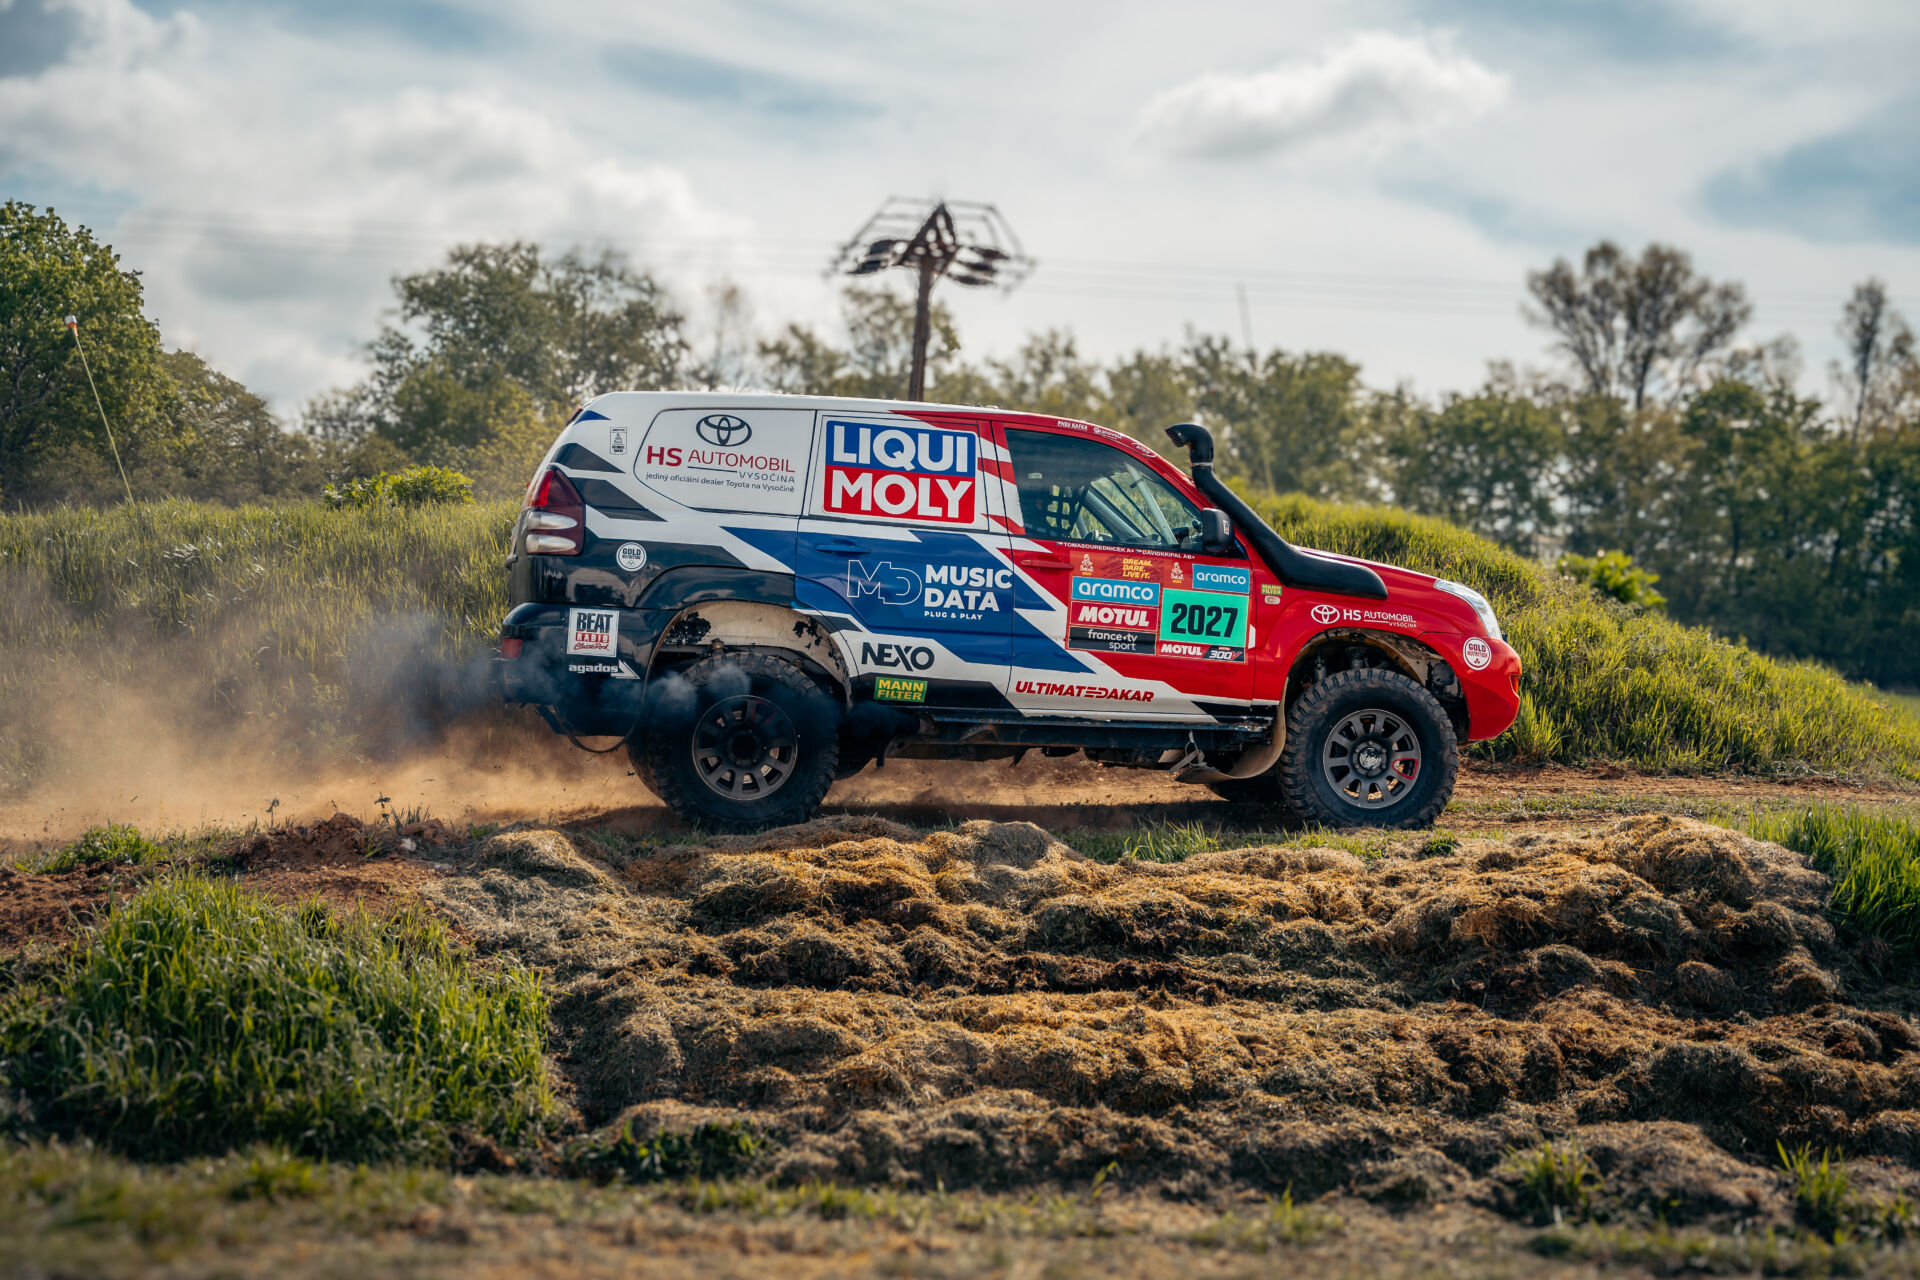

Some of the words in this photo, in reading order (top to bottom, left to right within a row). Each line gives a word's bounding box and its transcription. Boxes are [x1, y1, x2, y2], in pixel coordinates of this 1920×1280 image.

[833, 425, 968, 471] LIQUI
[646, 445, 682, 467] HS
[688, 449, 796, 473] AUTOMOBIL
[645, 471, 668, 482] jediný
[670, 473, 700, 484] oficiální
[700, 476, 724, 486] dealer
[726, 479, 750, 489] Toyota
[761, 483, 795, 493] Vysočině
[739, 470, 795, 484] VYSOČINA
[831, 469, 973, 519] MOLY
[622, 548, 642, 556] GOLD
[1122, 558, 1153, 567] DREAM.
[1122, 564, 1146, 572] DARE.
[925, 564, 1014, 589] MUSIC
[1196, 571, 1246, 585] aramco
[1078, 582, 1154, 600] aramco
[924, 587, 1000, 612] DATA
[576, 612, 613, 633] BEAT
[924, 611, 948, 619] PLUG
[960, 613, 983, 621] PLAY
[1077, 605, 1150, 627] MOTUL
[1170, 602, 1238, 638] 2027
[1343, 609, 1361, 621] HS
[1364, 610, 1417, 623] AUTOMOBIL
[576, 632, 609, 643] RADIO
[1108, 640, 1136, 652] sport
[1161, 643, 1203, 656] MOTUL
[1468, 643, 1487, 652] GOLD
[861, 642, 935, 671] NEXO
[1209, 649, 1243, 660] 300V
[568, 663, 619, 674] agados
[878, 679, 924, 692] MANN
[877, 690, 922, 701] FILTER
